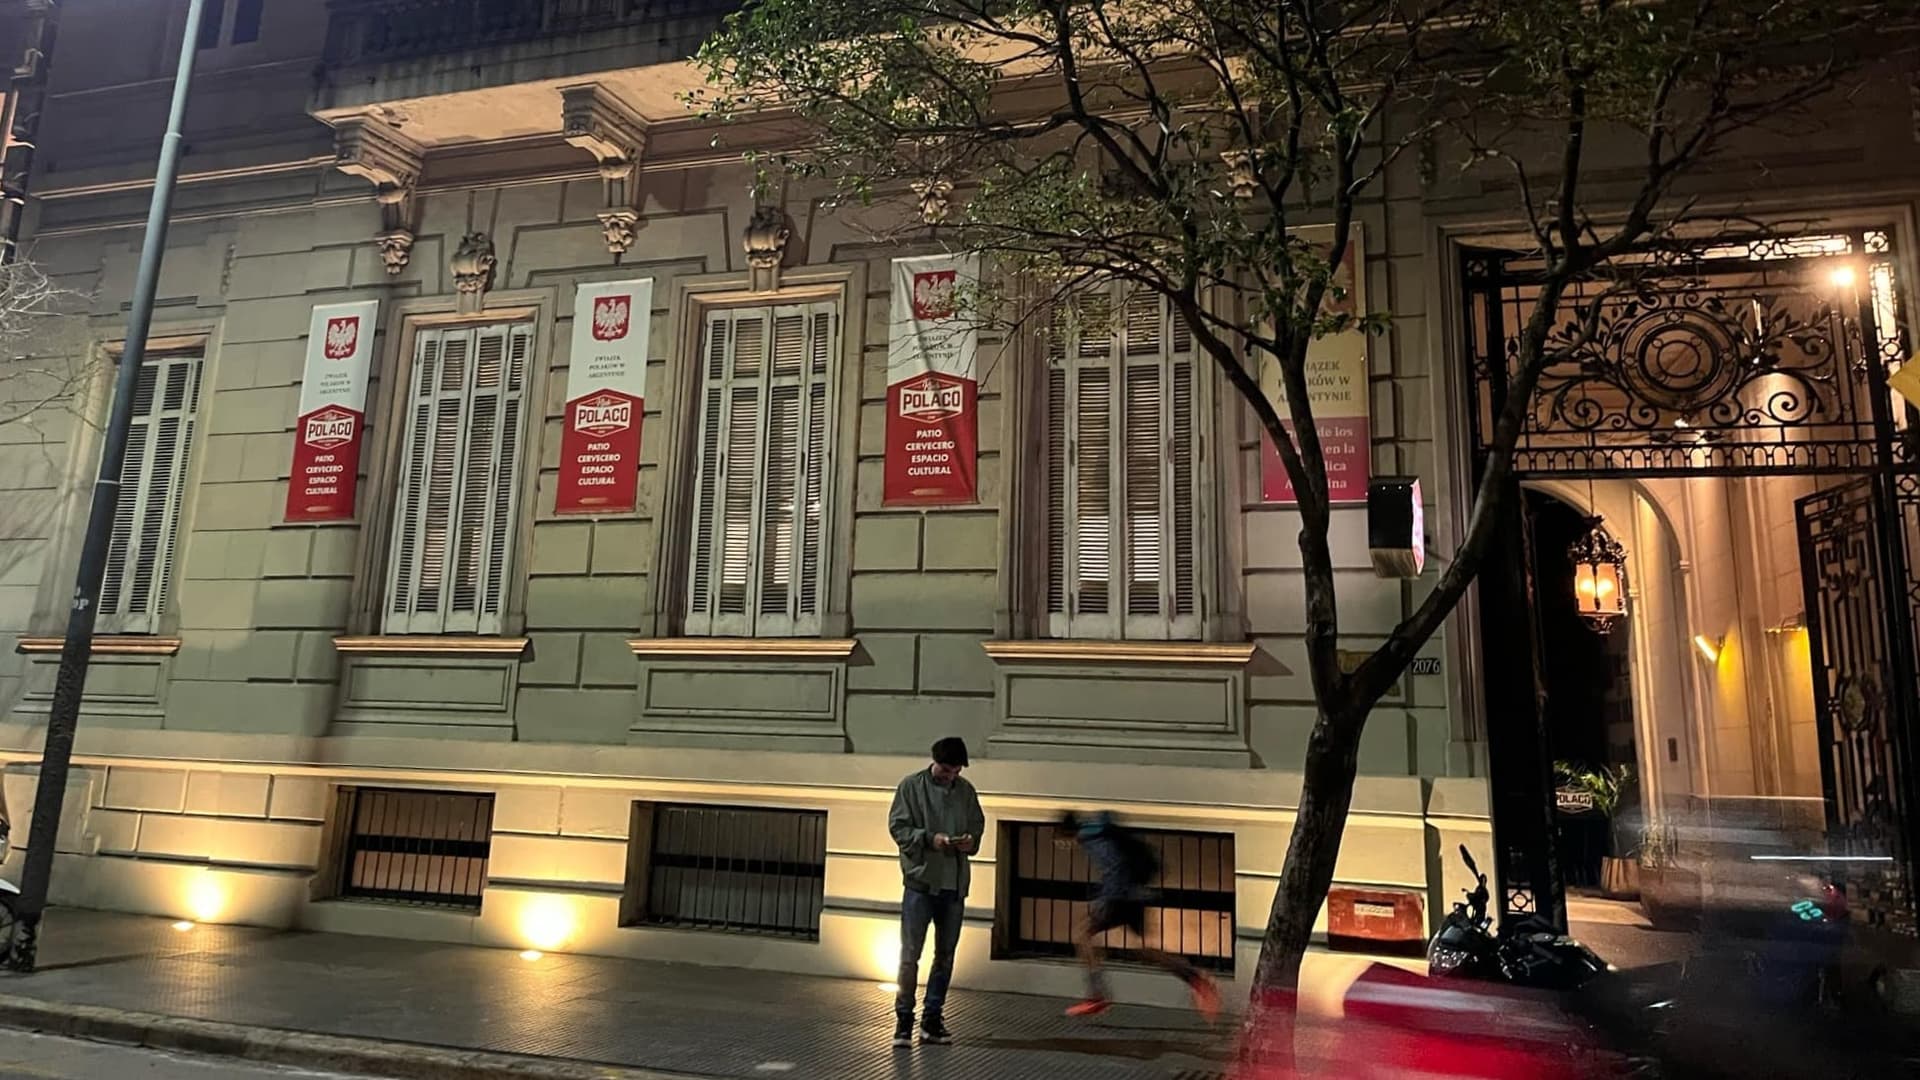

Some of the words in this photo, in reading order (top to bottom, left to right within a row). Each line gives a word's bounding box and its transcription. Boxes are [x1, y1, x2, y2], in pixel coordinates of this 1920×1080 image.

[1339, 375, 1351, 385] W
[902, 390, 961, 410] POLACO
[577, 407, 629, 425] POLACO
[308, 421, 352, 438] POLACO
[916, 429, 943, 438] PATIO
[1335, 426, 1354, 438] los
[587, 443, 610, 451] PATIO
[905, 441, 955, 451] CERVECERO
[1325, 445, 1341, 455] en
[1343, 442, 1355, 454] la
[577, 454, 621, 463] CERVECERO
[911, 454, 949, 463] ESPACIO
[581, 465, 615, 474] ESPACIO
[907, 466, 952, 476] CULTURAL
[1412, 659, 1440, 674] 2076
[1557, 793, 1591, 804] OLACO
